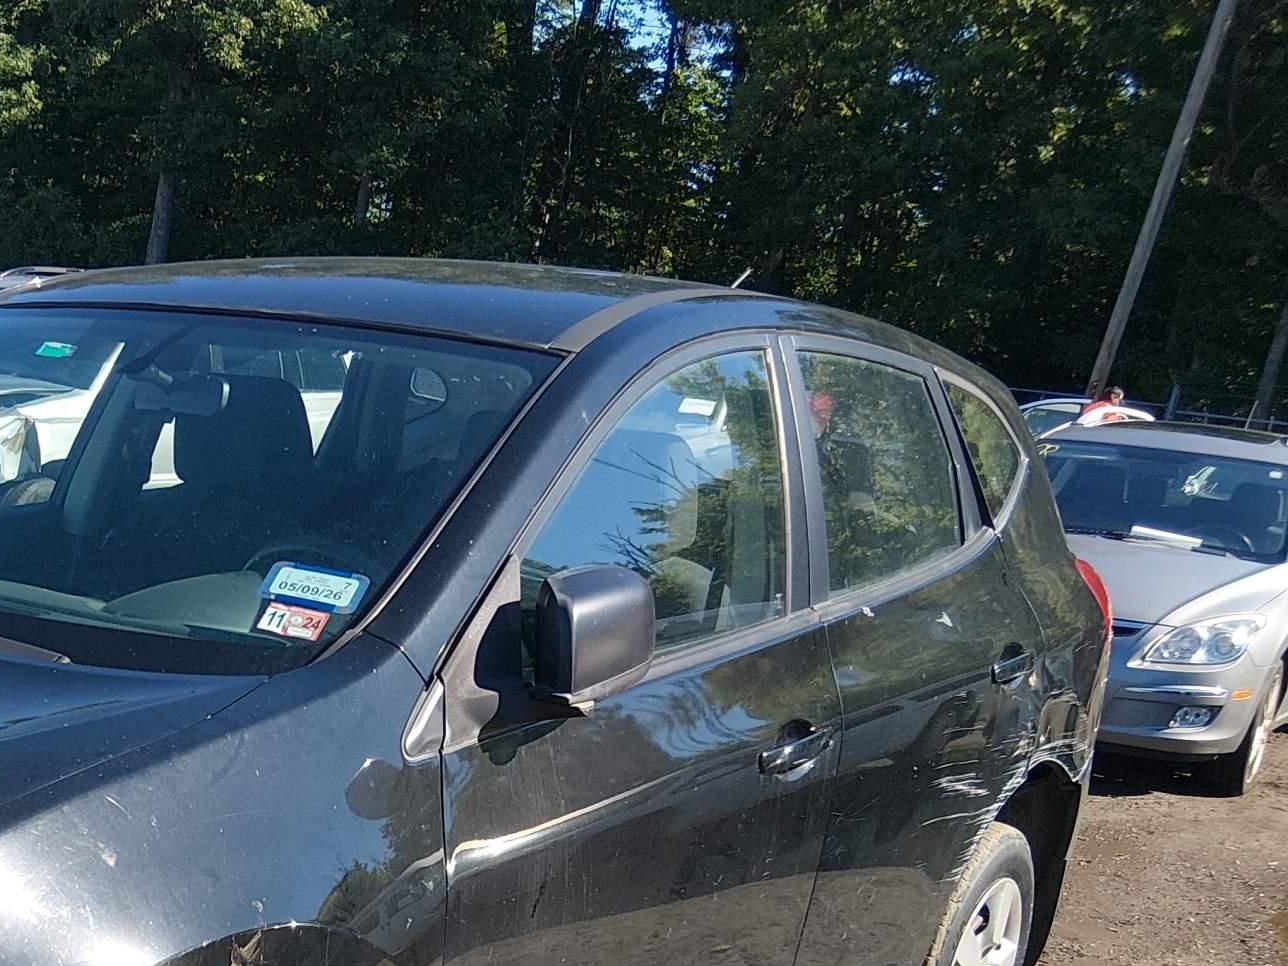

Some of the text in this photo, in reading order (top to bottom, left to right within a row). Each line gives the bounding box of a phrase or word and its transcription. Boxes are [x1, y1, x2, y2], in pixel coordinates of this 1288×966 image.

[278, 580, 343, 601] 05/09/26
[343, 582, 352, 590] 7
[267, 610, 287, 629] 11
[301, 616, 322, 632] 24
